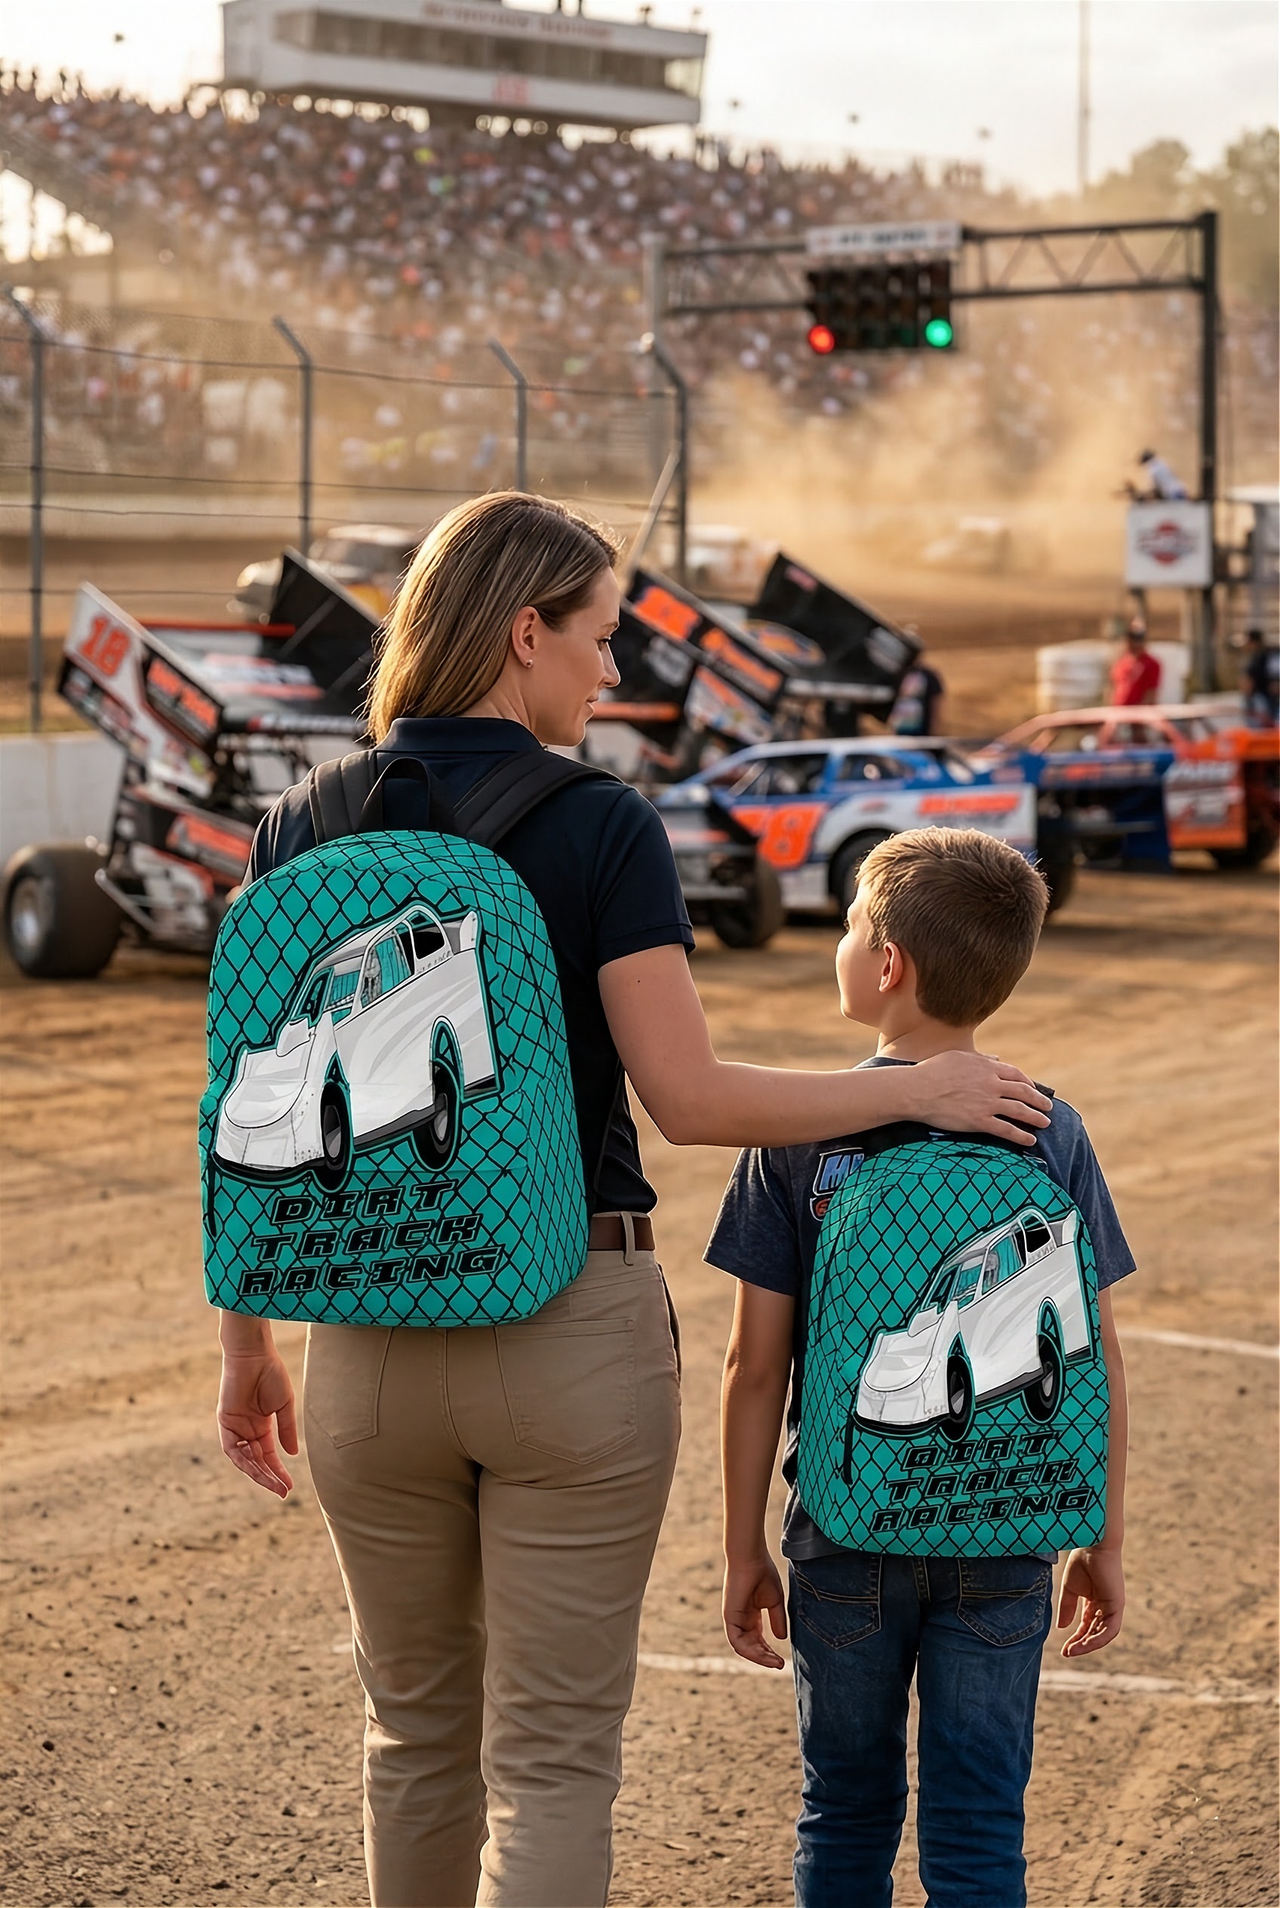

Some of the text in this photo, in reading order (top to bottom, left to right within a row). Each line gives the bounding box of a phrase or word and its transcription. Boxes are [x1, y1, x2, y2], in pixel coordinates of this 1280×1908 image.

[80, 616, 131, 677] 18
[271, 1180, 458, 1225] DIRT
[251, 1214, 483, 1262] TRACK
[239, 1244, 505, 1296] RACING
